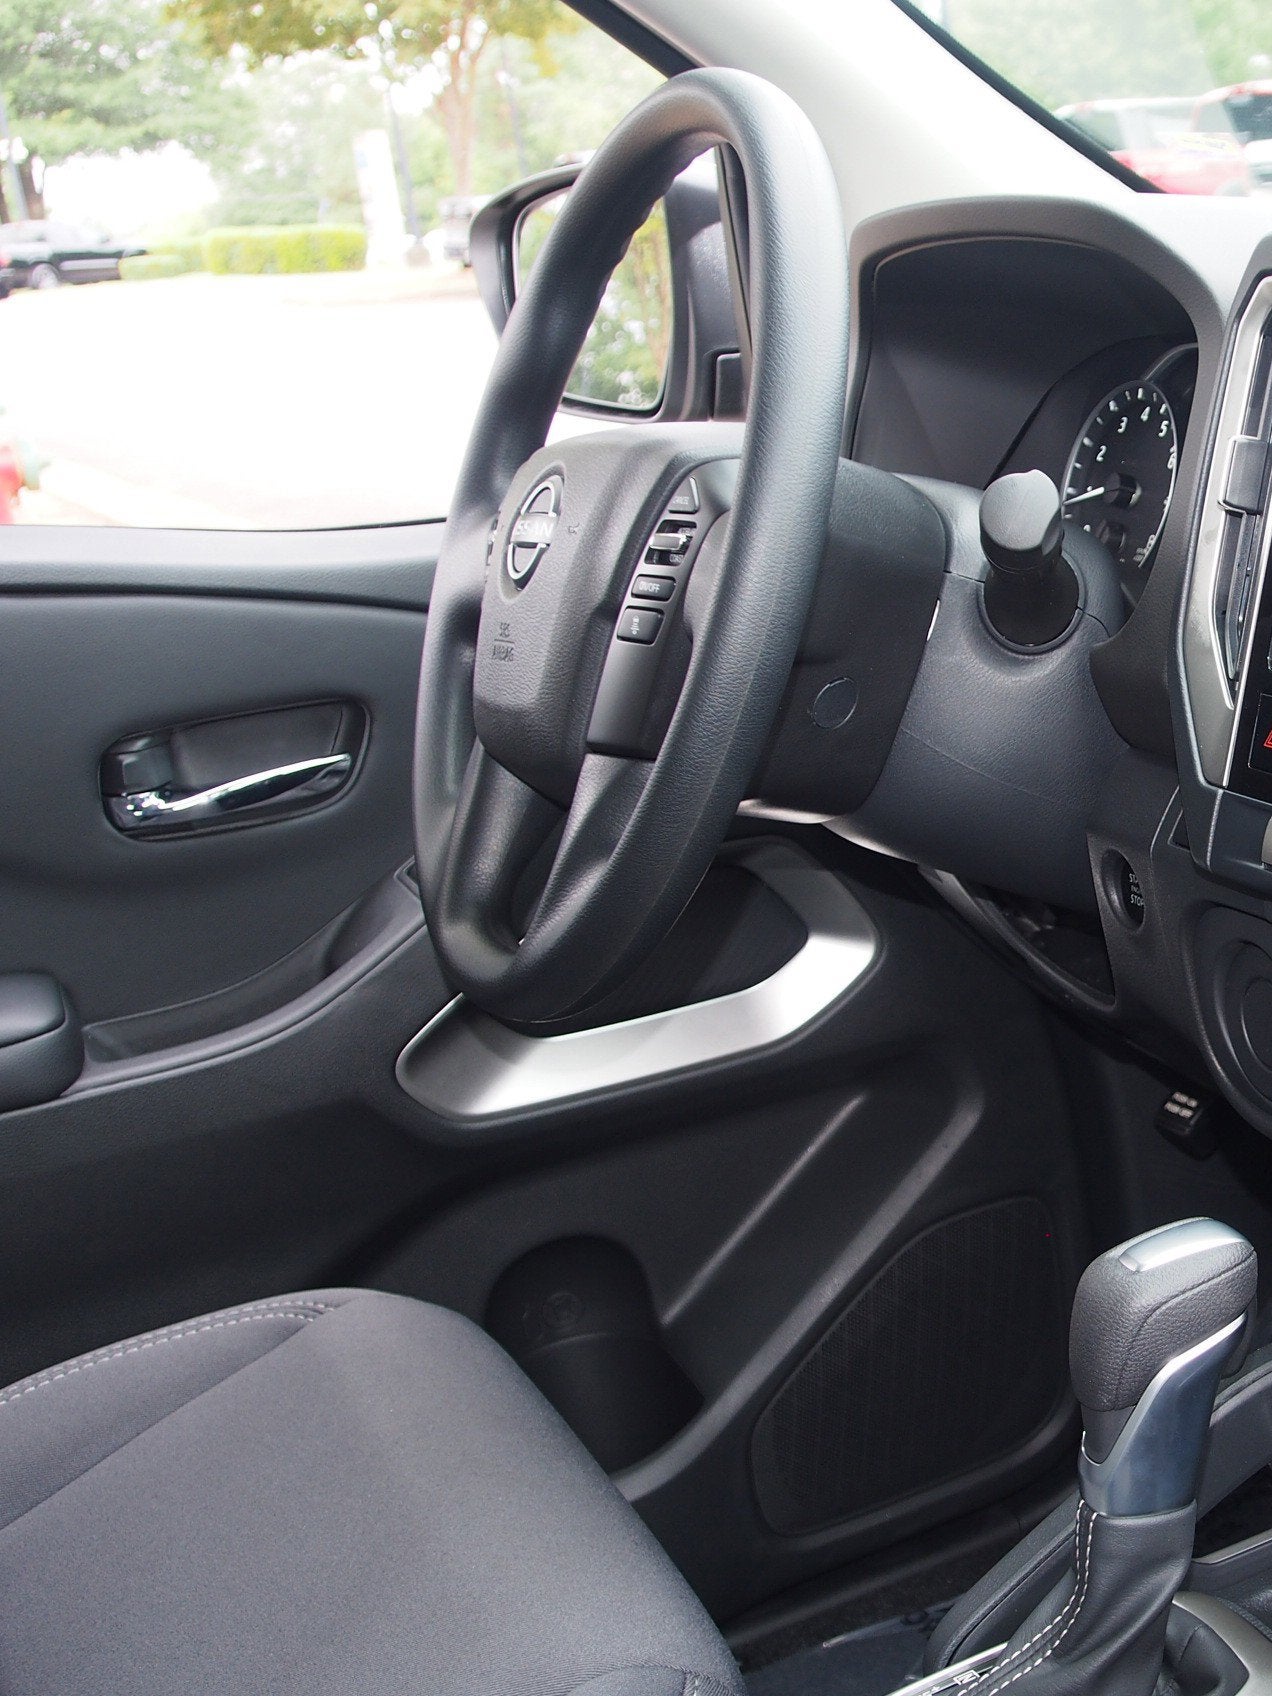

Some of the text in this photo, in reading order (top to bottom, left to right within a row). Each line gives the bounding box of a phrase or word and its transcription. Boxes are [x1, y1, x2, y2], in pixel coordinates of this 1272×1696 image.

[1140, 406, 1151, 422] 4
[1117, 416, 1128, 434] 3
[1158, 420, 1170, 437] 5
[1096, 445, 1107, 462] 2
